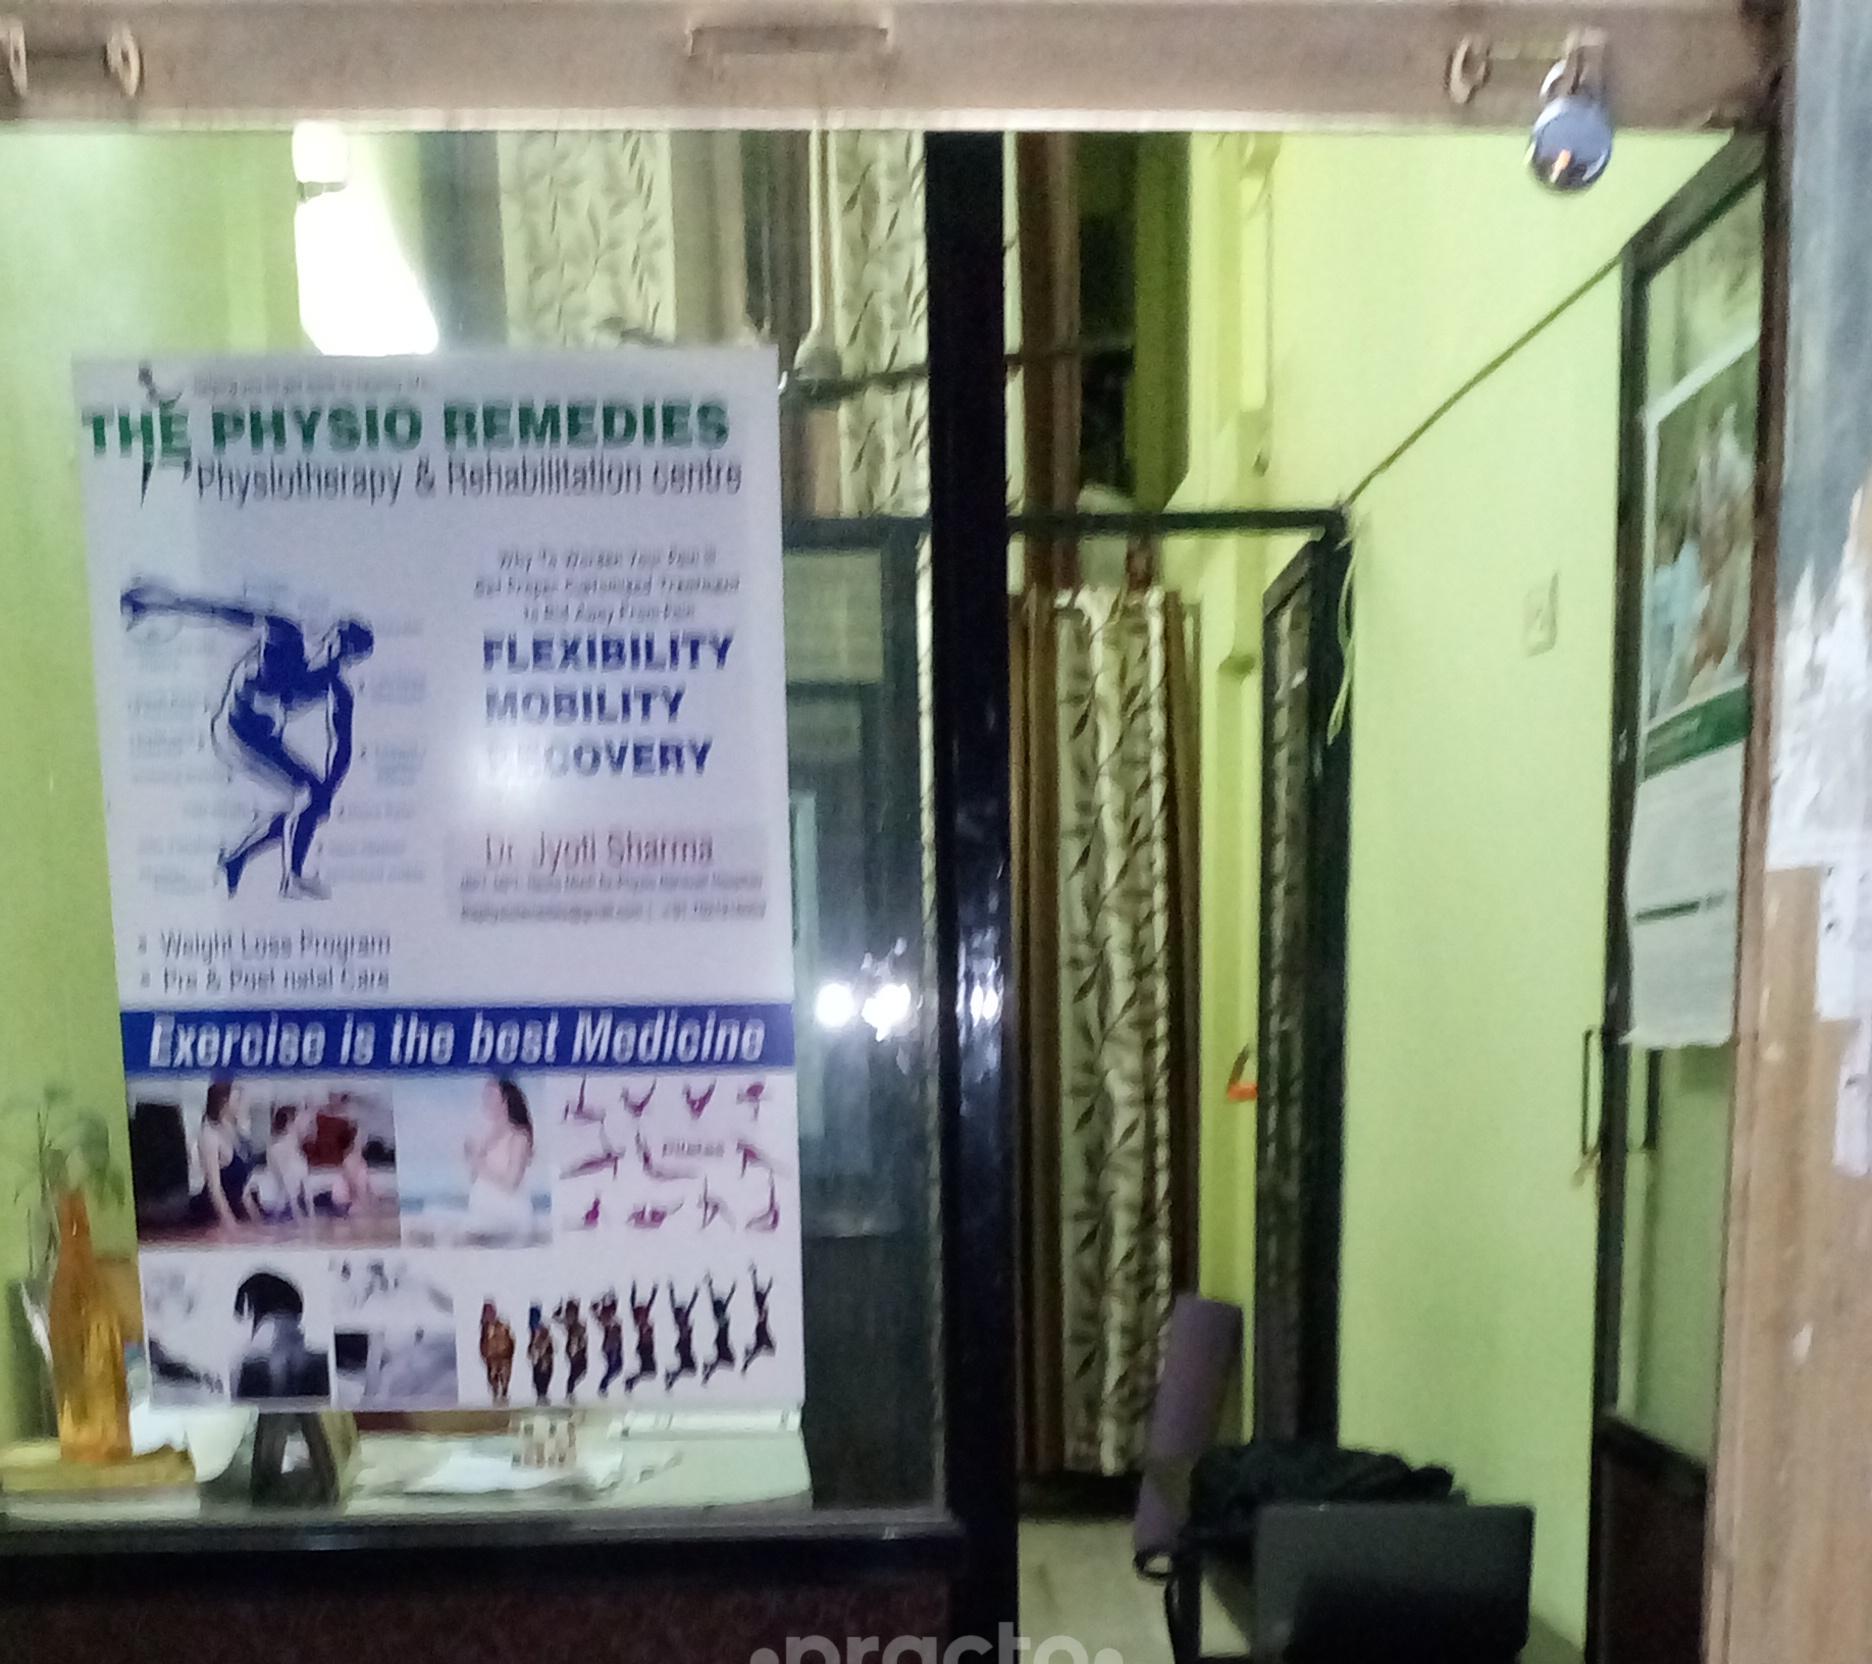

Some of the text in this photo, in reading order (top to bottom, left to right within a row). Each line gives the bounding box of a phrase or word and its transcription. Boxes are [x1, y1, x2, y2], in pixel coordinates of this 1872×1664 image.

[80, 398, 730, 459] THE PHYSIO REMEDIES
[415, 455, 436, 498] &
[448, 453, 642, 497] Rehabilitation
[482, 630, 733, 672] FLEXIBILITY
[484, 683, 686, 725] MOBILITY
[606, 830, 714, 868] Sharma
[299, 927, 392, 966] Program
[150, 1007, 766, 1068] Exercise is the best Medicine
